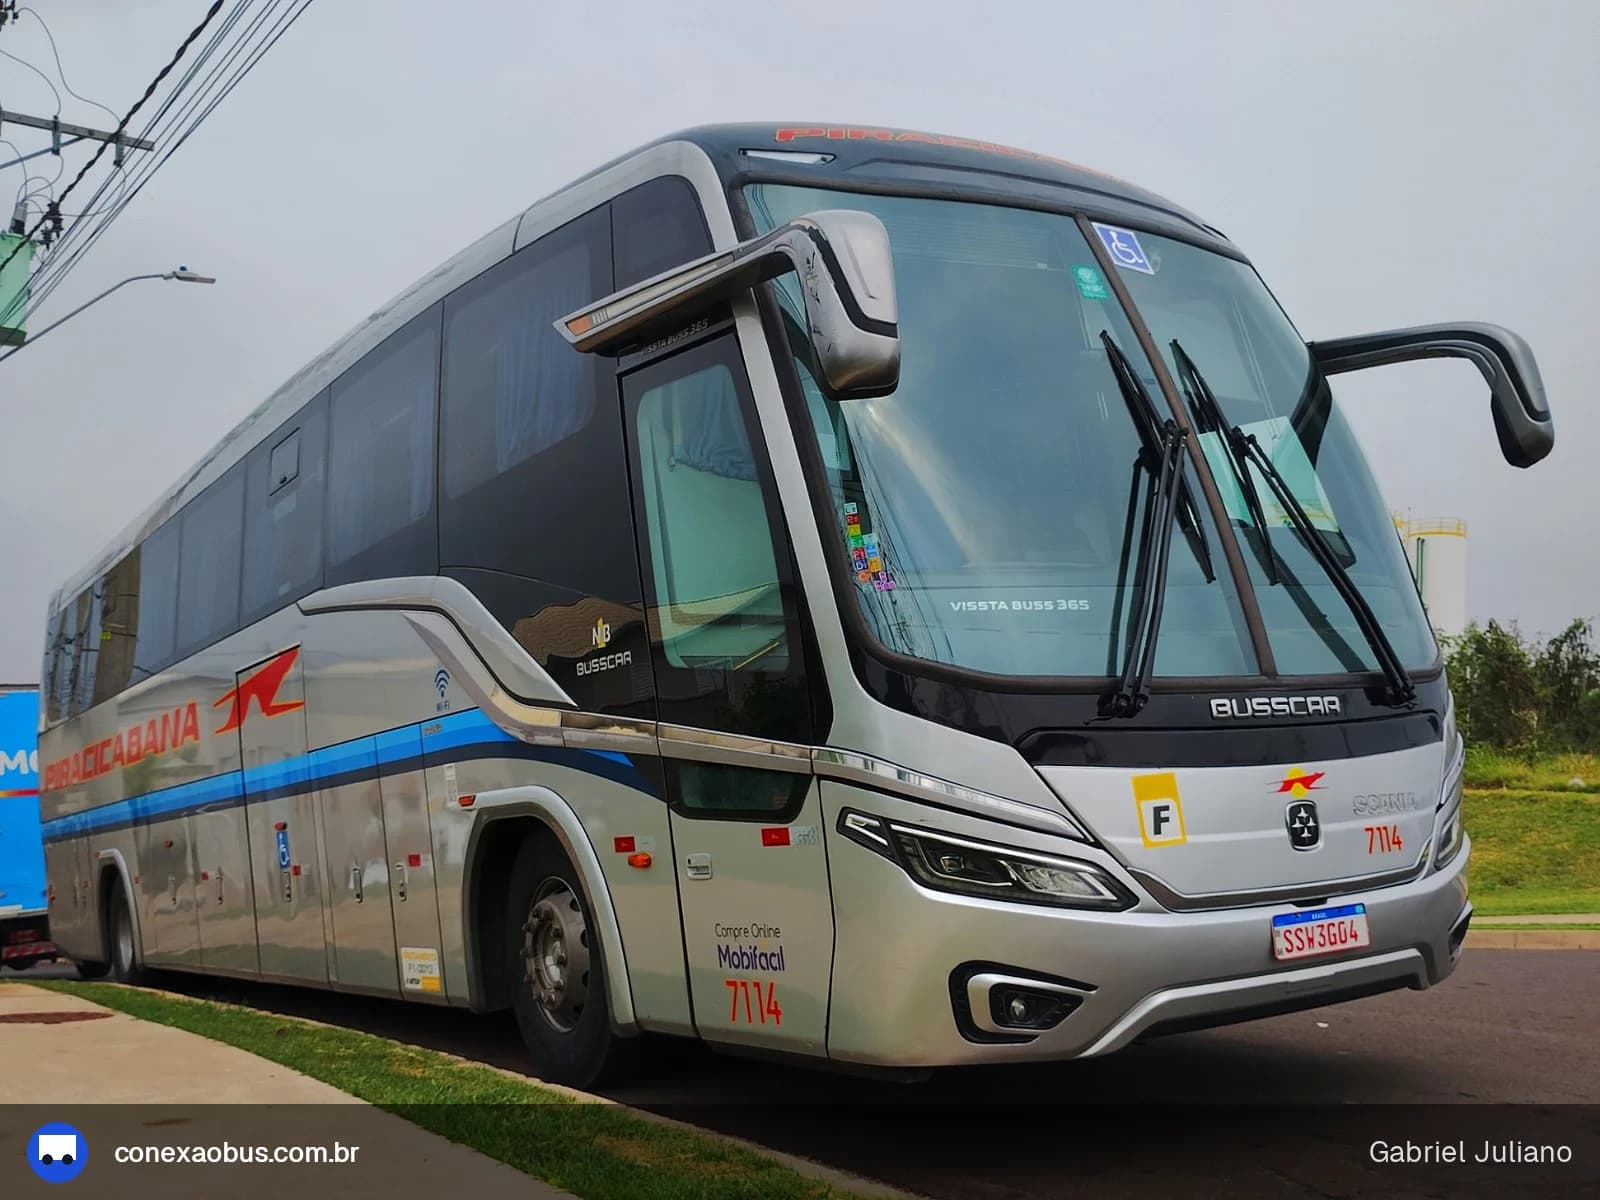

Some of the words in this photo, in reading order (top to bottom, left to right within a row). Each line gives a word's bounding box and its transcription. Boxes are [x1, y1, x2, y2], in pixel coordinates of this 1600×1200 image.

[950, 601, 1009, 612] VISSTA
[1011, 600, 1055, 611] BUSS
[1056, 599, 1090, 611] 365
[576, 650, 632, 676] BUSSCAR
[1210, 696, 1341, 718] BUSSCAR
[44, 701, 200, 792] PIRACICABANA
[1153, 805, 1170, 835] F
[1364, 825, 1402, 854] 7114
[715, 922, 749, 941] Compre
[751, 922, 781, 939] Online
[1283, 920, 1359, 954] SSW3G04
[724, 979, 783, 1025] 7114
